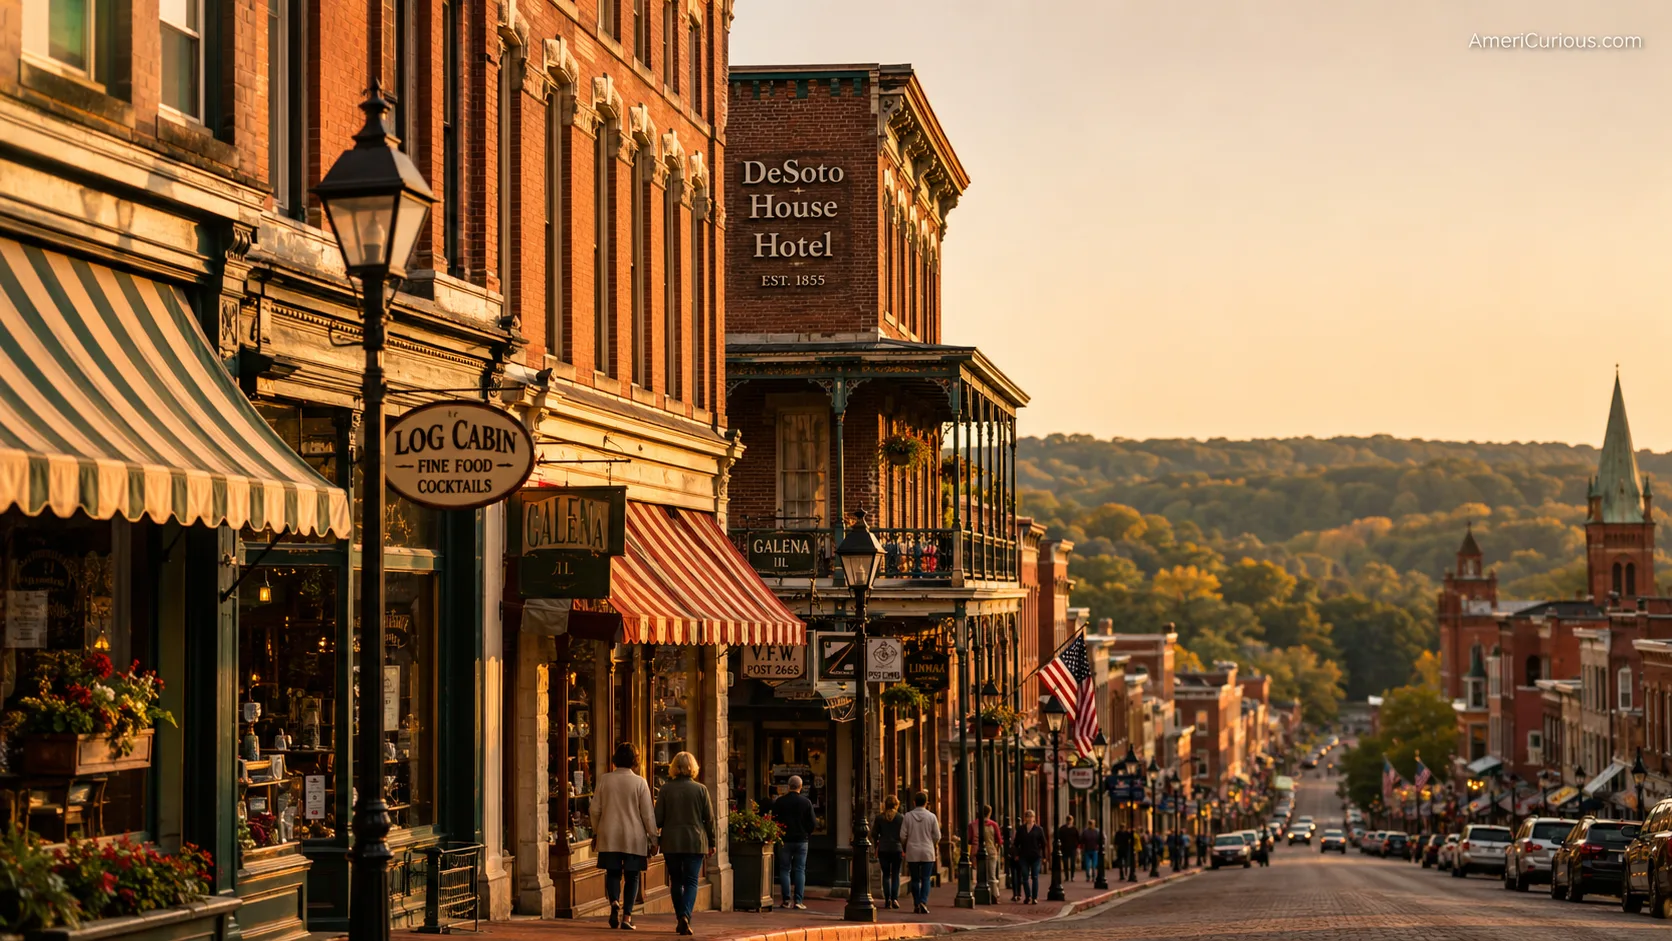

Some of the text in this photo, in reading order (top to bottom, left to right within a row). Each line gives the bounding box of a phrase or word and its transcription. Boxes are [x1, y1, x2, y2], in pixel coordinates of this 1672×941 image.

[742, 159, 844, 185] DeSoto
[748, 194, 838, 219] House
[753, 231, 833, 257] Hotel
[761, 274, 826, 287] EST. 1855
[394, 424, 445, 456] LOG
[417, 459, 493, 474] FINE FOOD
[417, 479, 492, 494] COCKTAILS
[753, 538, 811, 554] GALENA
[751, 643, 797, 662] V.F.W.
[747, 664, 772, 675] POST
